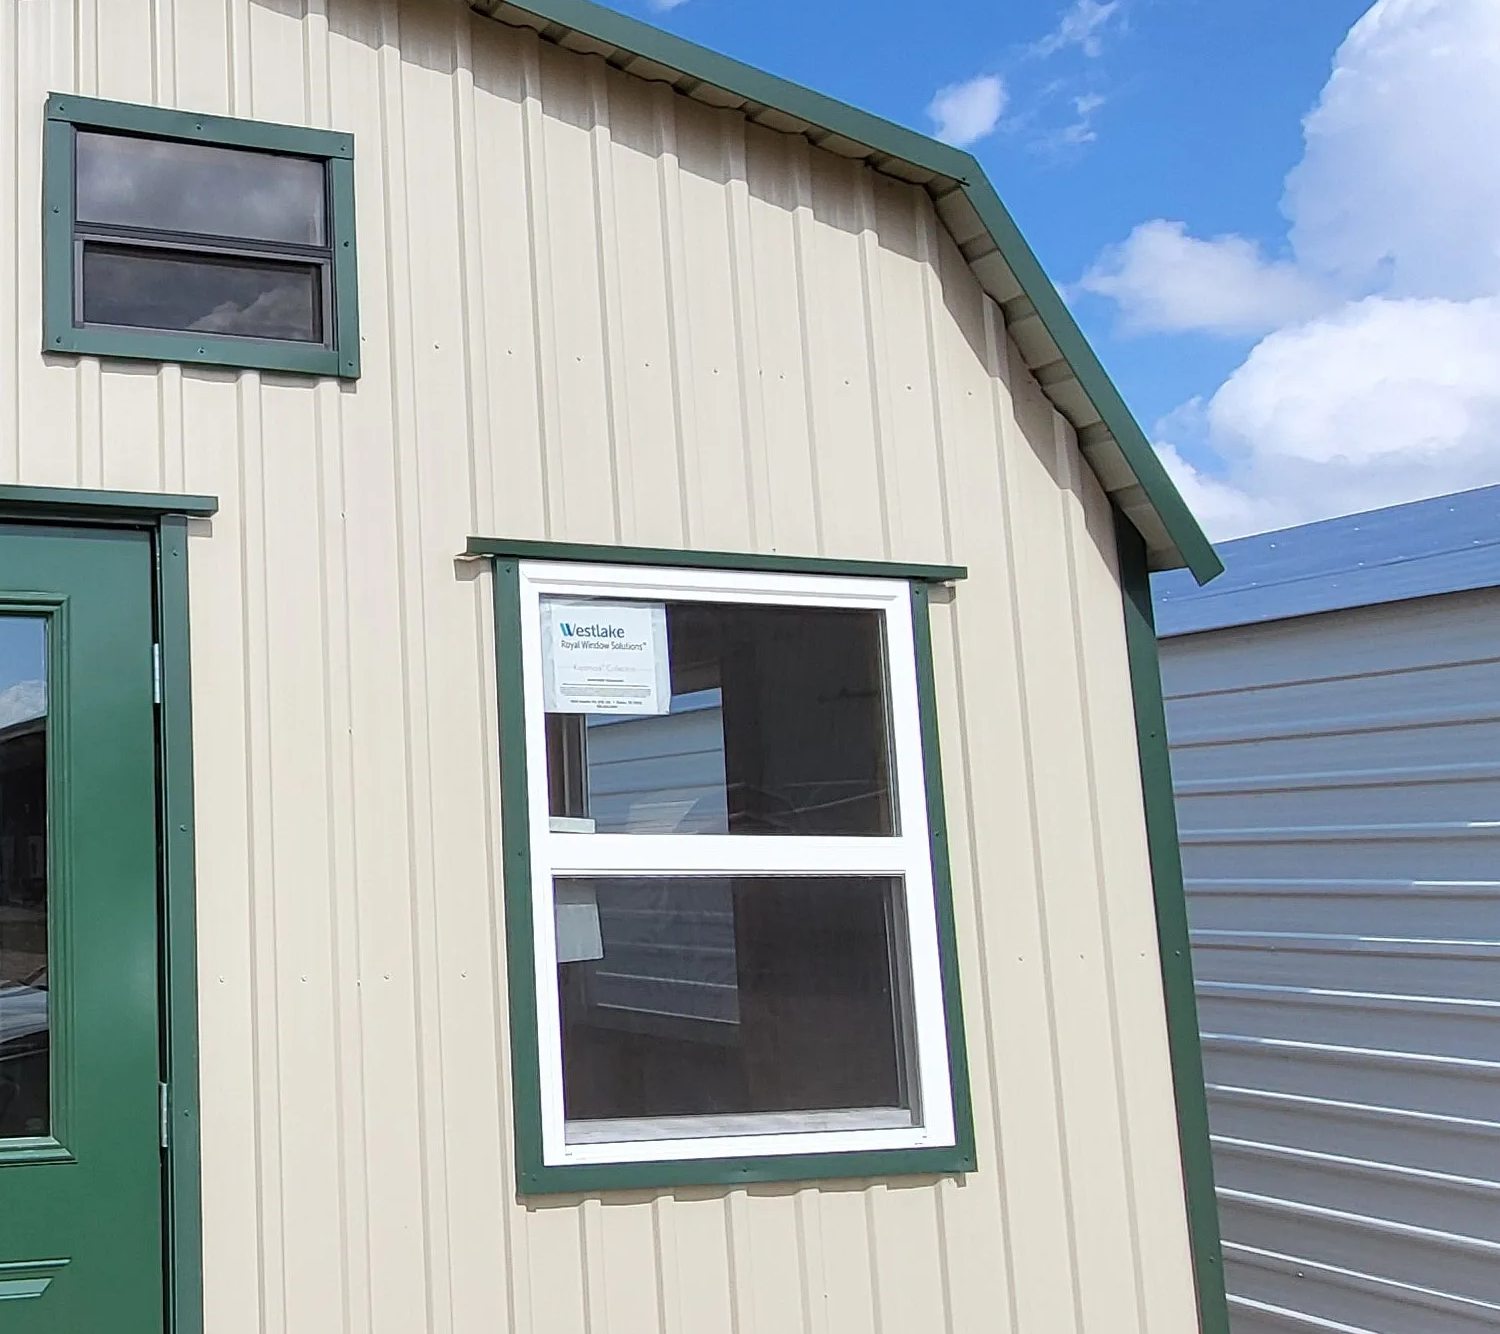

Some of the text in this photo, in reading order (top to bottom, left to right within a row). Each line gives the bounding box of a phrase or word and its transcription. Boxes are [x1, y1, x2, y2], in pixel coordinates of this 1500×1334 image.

[560, 622, 625, 638] Westlake
[561, 640, 580, 651] Royal
[582, 641, 610, 650] Window
